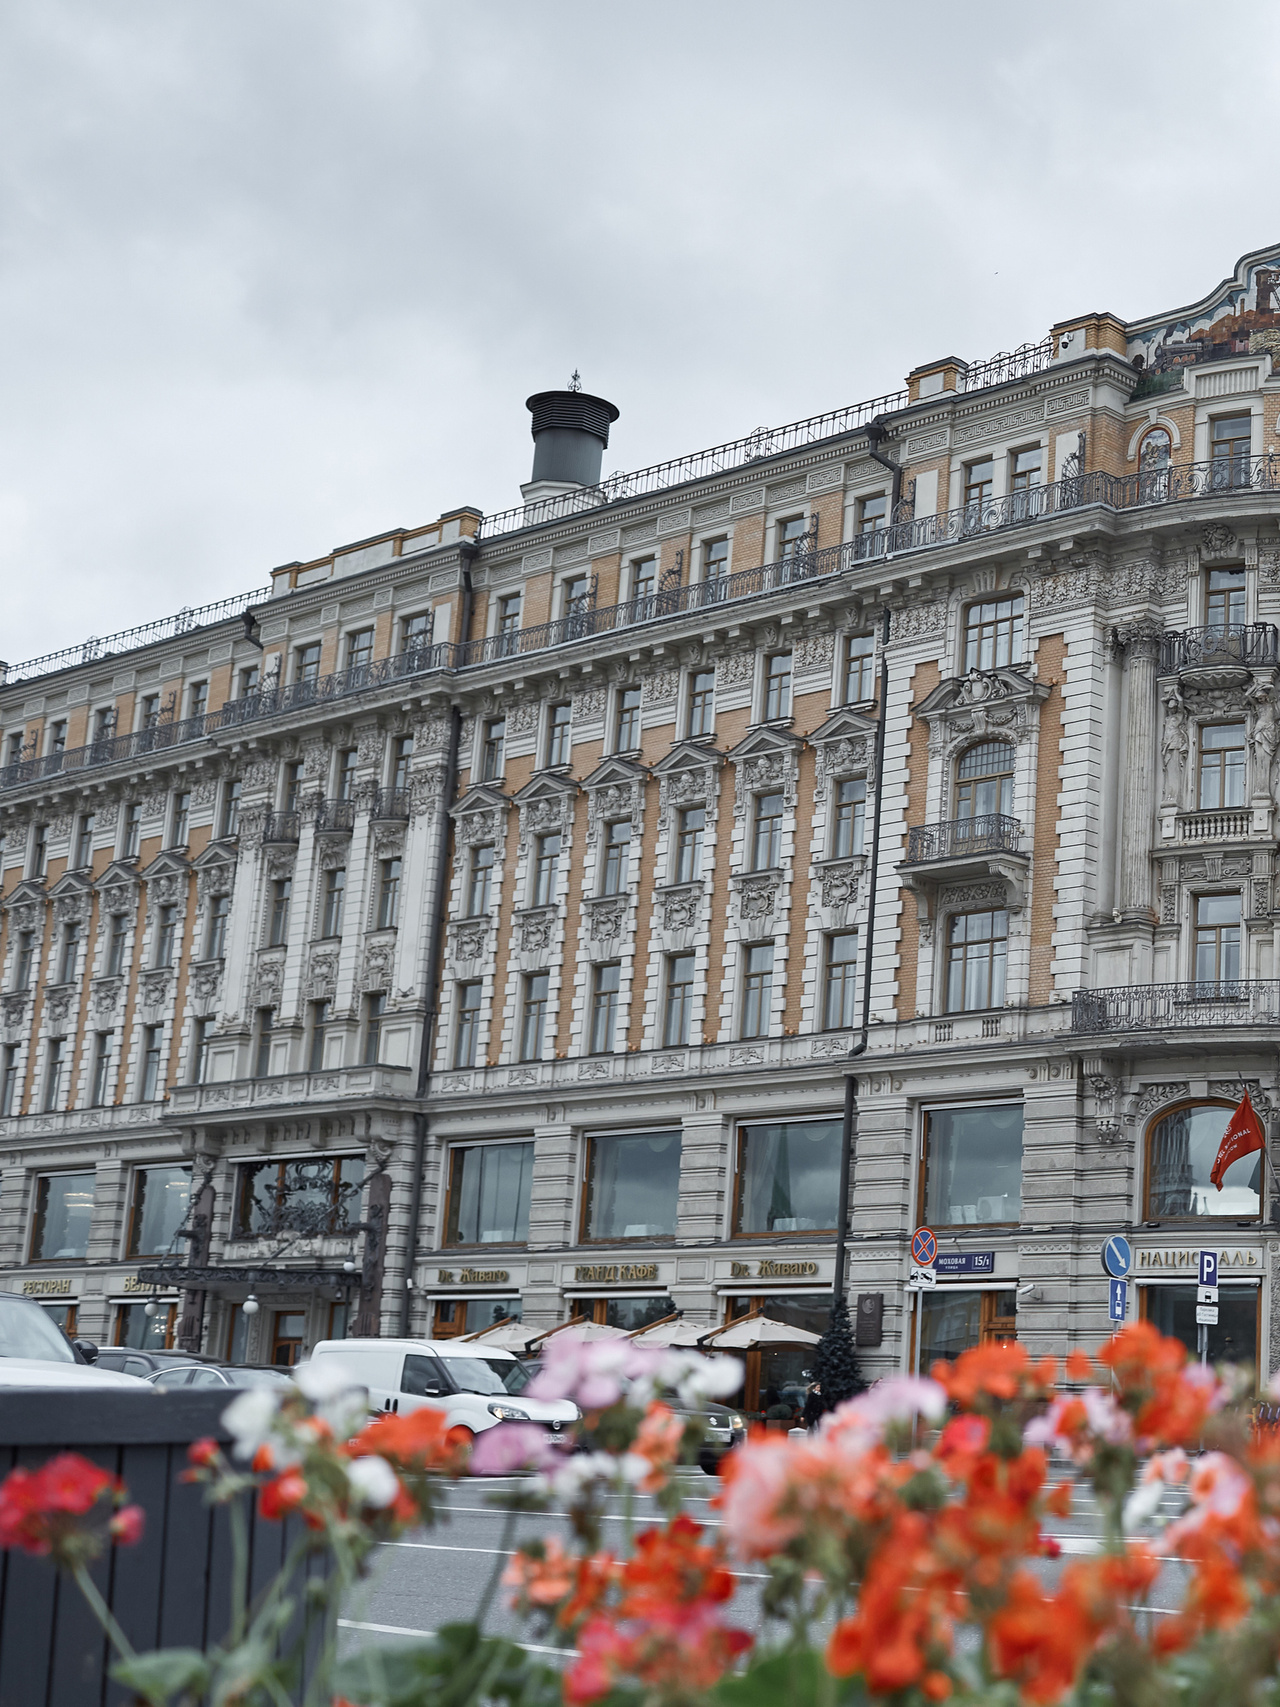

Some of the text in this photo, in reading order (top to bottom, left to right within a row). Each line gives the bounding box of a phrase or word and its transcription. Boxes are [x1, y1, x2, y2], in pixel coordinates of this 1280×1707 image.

[938, 1255, 990, 1267] МОХОВАЯ 15/1
[1139, 1251, 1258, 1267] НАЦИОАЛЬ
[459, 1267, 509, 1282] Живаго
[574, 1263, 658, 1282] ГРАНД КАФЕ
[757, 1259, 819, 1276] Живаго
[22, 1279, 72, 1294] РЕСТОРАН
